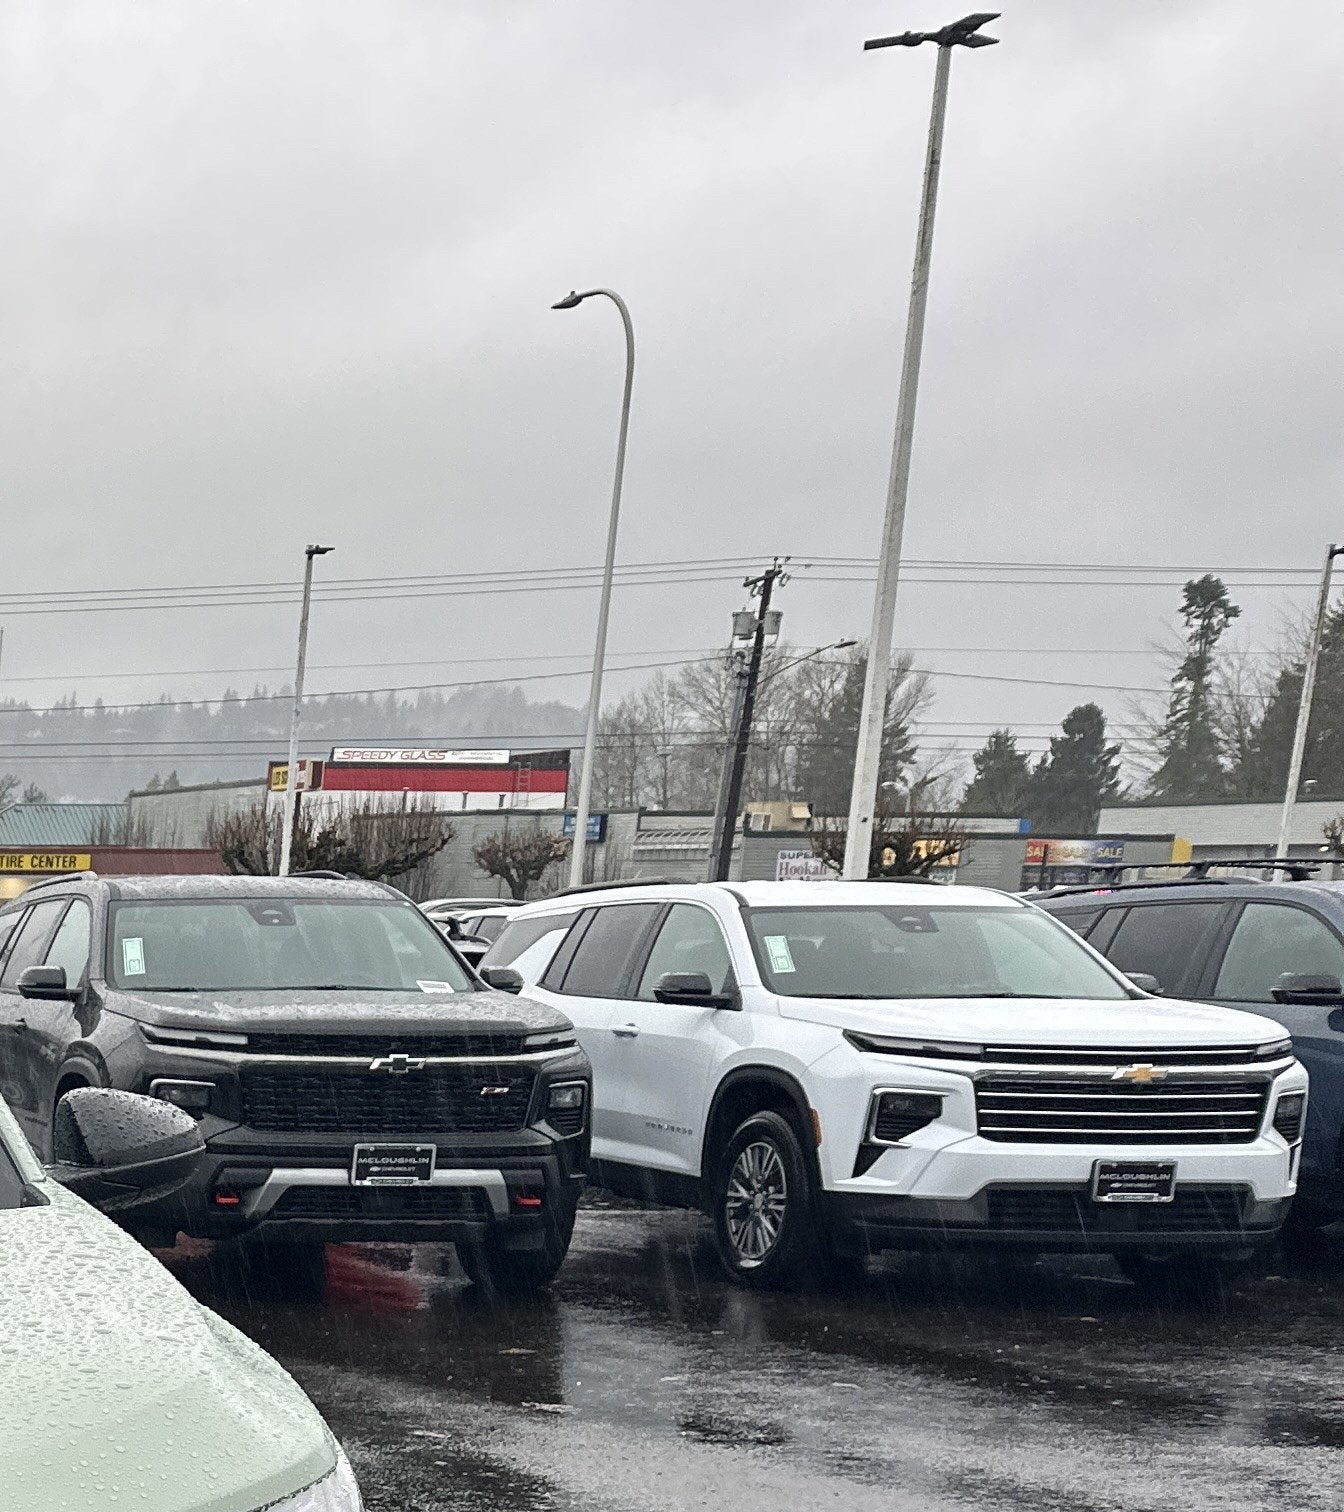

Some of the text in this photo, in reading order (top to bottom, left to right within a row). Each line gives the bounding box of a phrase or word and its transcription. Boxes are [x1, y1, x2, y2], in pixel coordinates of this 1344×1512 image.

[336, 750, 449, 760] SPEEDY GLASS
[1097, 847, 1123, 857] SALE
[0, 854, 25, 869] TIRE
[30, 855, 77, 869] CENTER
